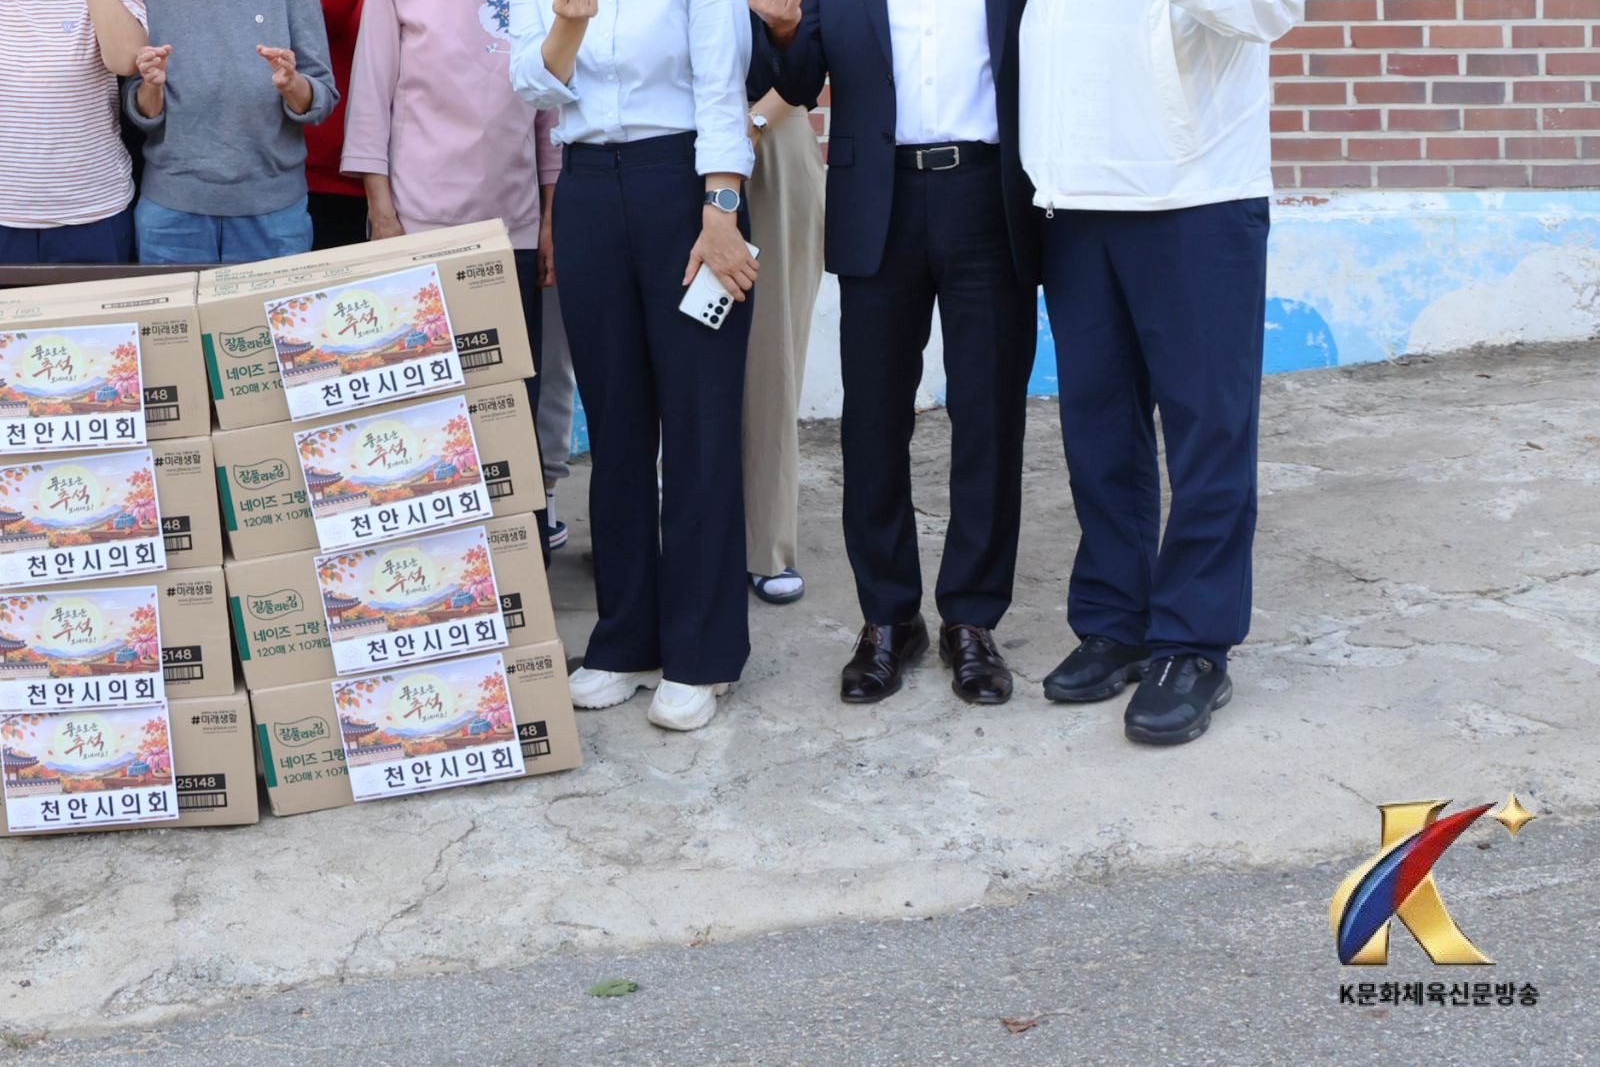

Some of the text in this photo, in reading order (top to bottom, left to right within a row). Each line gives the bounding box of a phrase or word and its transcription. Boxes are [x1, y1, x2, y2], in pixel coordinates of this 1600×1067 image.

[456, 263, 504, 281] #미래생활
[142, 323, 188, 335] #미래생활
[338, 308, 379, 336] 추석
[32, 356, 73, 381] 추석
[226, 363, 265, 380] 네이즈
[230, 383, 259, 396] 120매
[322, 357, 453, 407] 천안시의회
[468, 397, 515, 414] #미래생활
[6, 416, 136, 446] 천안시의회
[155, 454, 201, 467] #미래생활
[368, 439, 408, 467] 추석
[239, 464, 284, 484] 잘풀리는집
[50, 486, 90, 511] 추석
[240, 496, 278, 512] 네이즈
[243, 515, 273, 527] 120매
[351, 489, 482, 538] 천안시의회
[487, 529, 527, 544] 미래생활
[27, 542, 156, 578] 천안시의회
[166, 584, 213, 597] #미래생활
[386, 567, 426, 594] 추석
[253, 594, 298, 614] 잘풀리는집
[52, 618, 93, 642] 추석
[253, 621, 320, 642] 네이즈 그랑
[367, 618, 498, 663] 천안시의회
[257, 645, 286, 657] 120매
[506, 659, 552, 675] #미래생활
[27, 677, 155, 706] 천안시의회
[403, 693, 443, 720] 추석
[191, 713, 237, 725] #미래생활
[280, 722, 324, 741] 잘풀리는집
[64, 732, 104, 757] 추석
[280, 753, 318, 769] 네이즈
[384, 746, 514, 789] 천안시의회
[283, 772, 312, 784] 120매
[40, 790, 168, 823] 천안시의회
